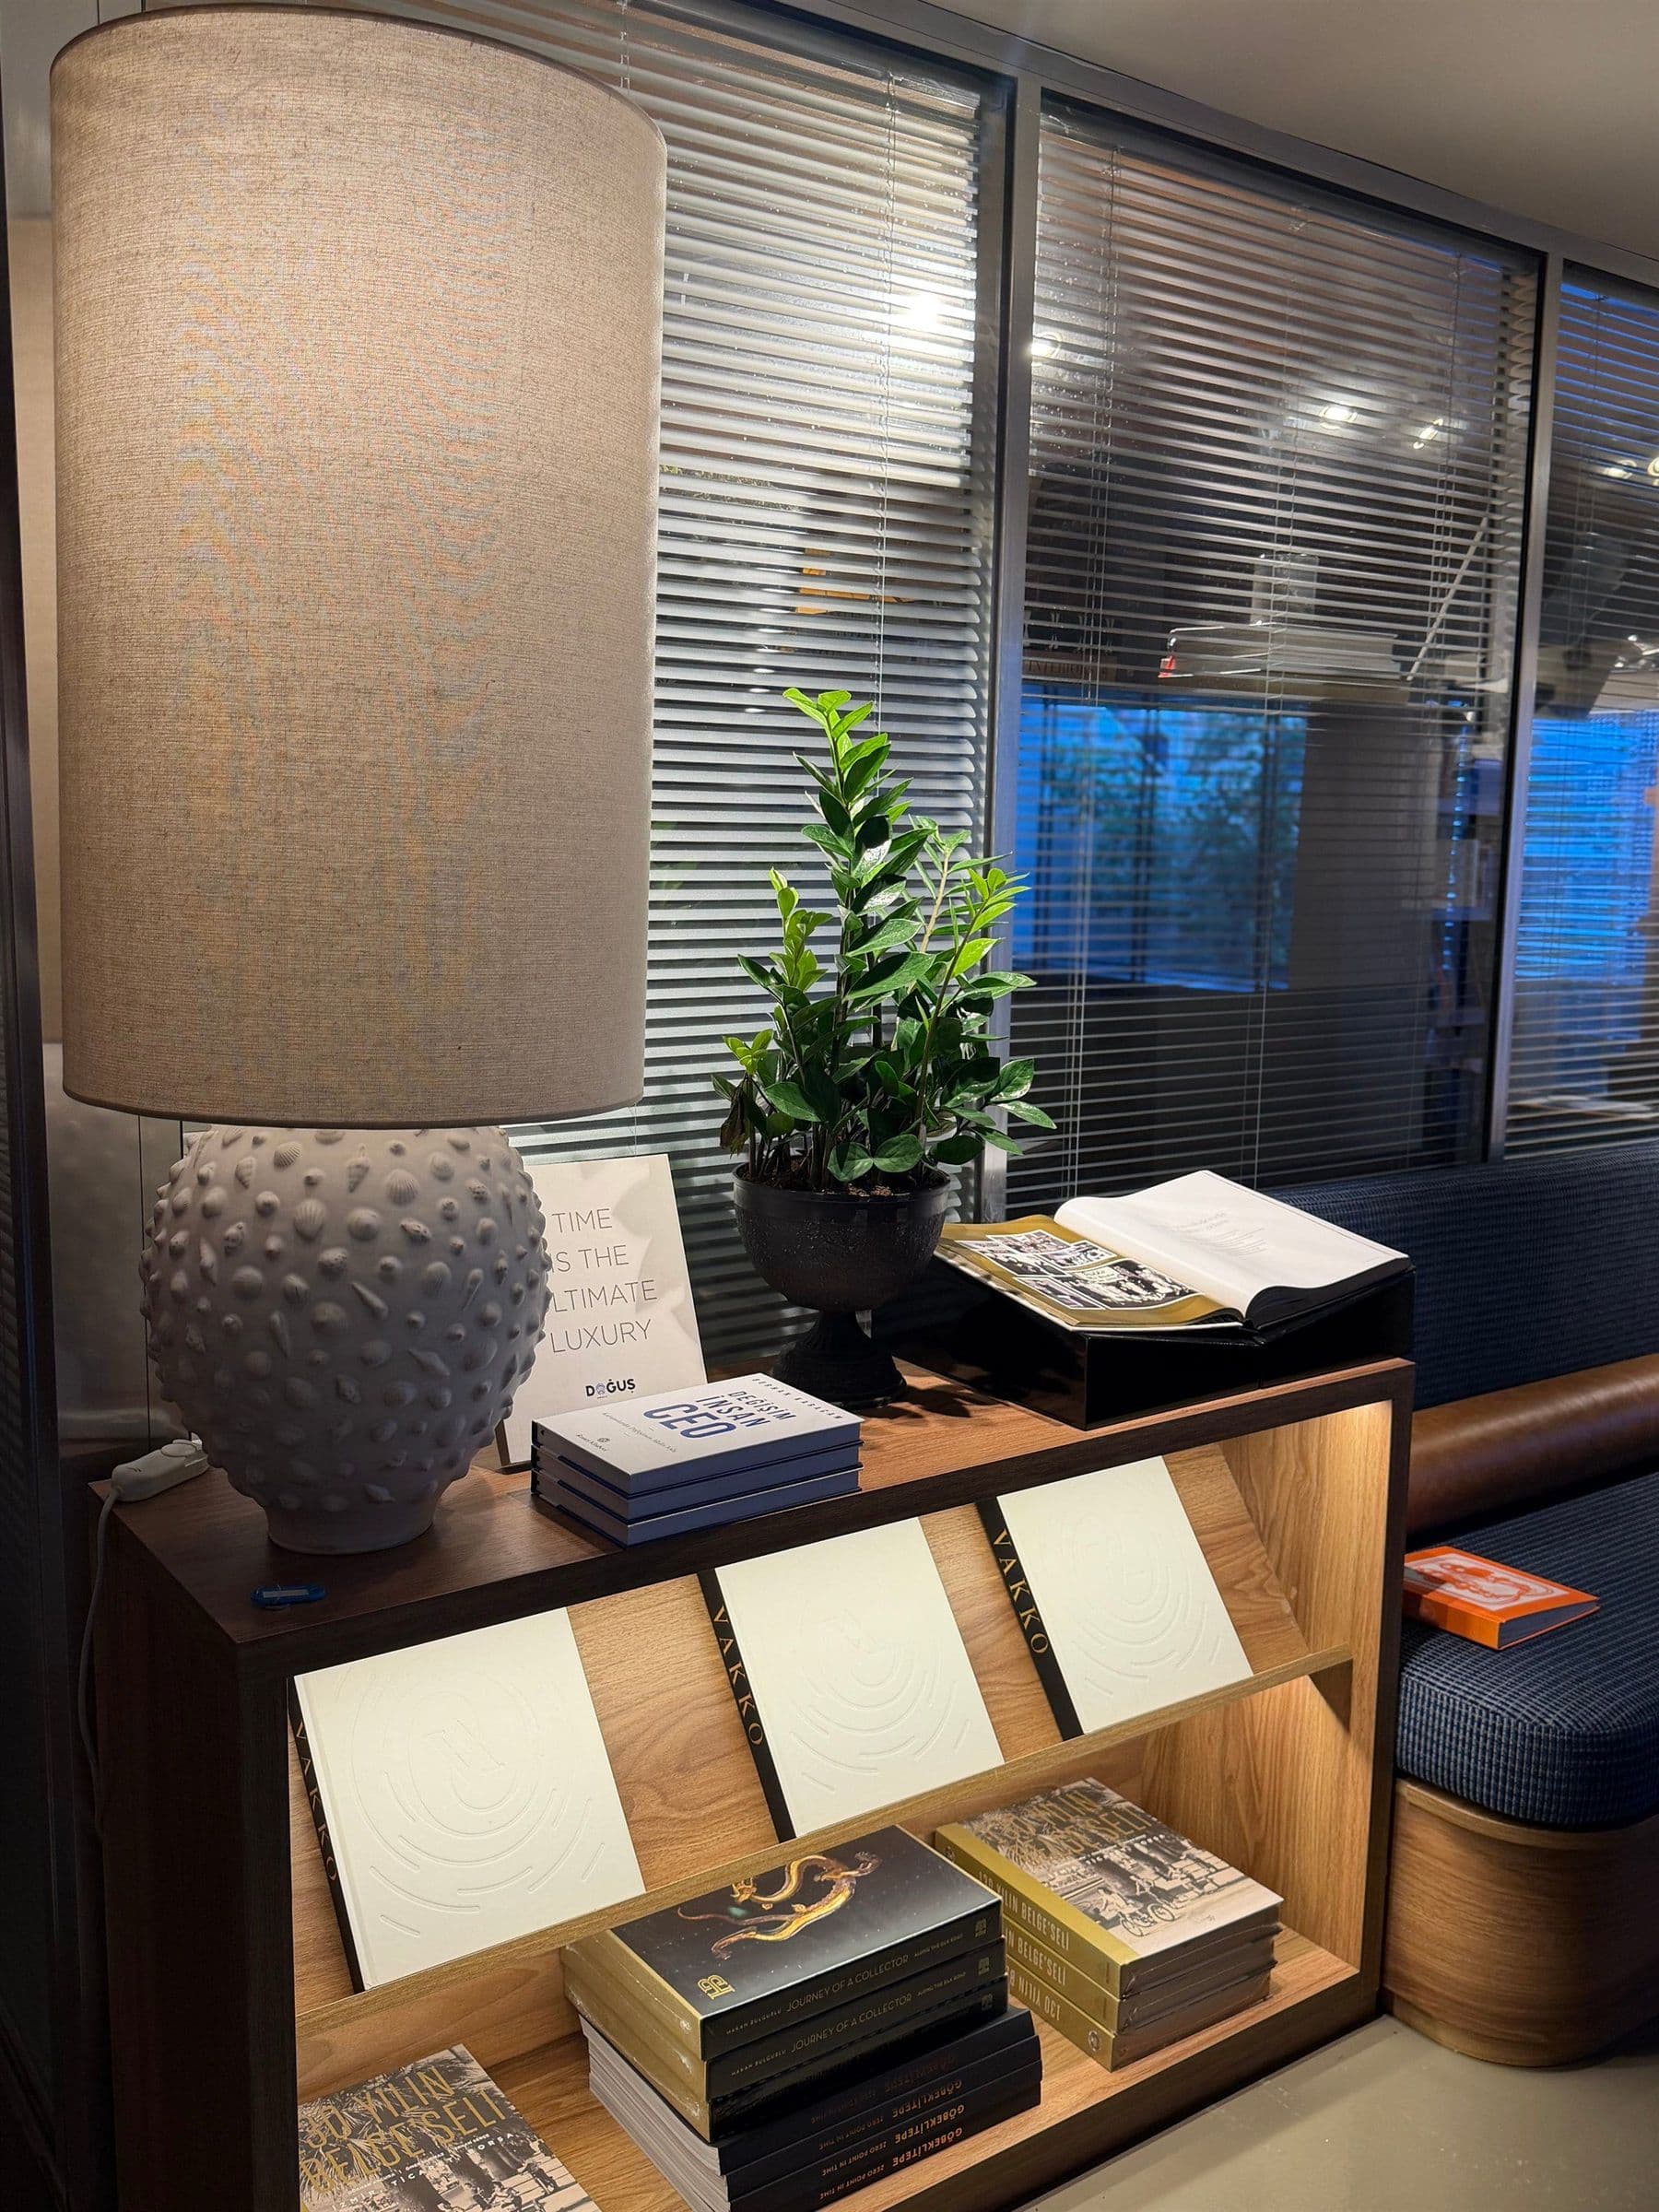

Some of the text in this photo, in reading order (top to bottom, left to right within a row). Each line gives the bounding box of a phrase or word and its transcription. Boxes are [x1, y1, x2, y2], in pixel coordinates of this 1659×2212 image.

[552, 1208, 612, 1233] TIME
[578, 1244, 629, 1269] THE
[553, 1279, 657, 1312] LTIMATE
[550, 1319, 651, 1353] LUXURY
[643, 1404, 737, 1439] CEO
[696, 1394, 771, 1427] İNSAN
[728, 1390, 797, 1421] DEĞİŞİM
[994, 1528, 1049, 1654] VAKKO
[713, 1606, 763, 1746] VAKKO
[296, 1721, 337, 1881] VAKKO
[1021, 1902, 1069, 1951] BELGE'SELİ
[1018, 1941, 1066, 1987] BELGE'SELİ
[786, 1986, 831, 2013] JOURNEY
[831, 1980, 846, 1994] OF
[847, 1977, 854, 1987] A
[855, 1954, 909, 1983] COLLECTOR
[1018, 1975, 1041, 2006] YILIN
[791, 2028, 834, 2053] JOURNEY
[836, 2019, 849, 2033] OF
[851, 2018, 858, 2026] A
[859, 1994, 912, 2023] COLLECTOR
[1043, 1994, 1061, 2021] 130
[352, 2065, 455, 2124] YILIN
[892, 2079, 962, 2118] GÖBEKLİTEPE
[821, 2104, 965, 2176] GÖBEKLİTEPE ZERO POINT IN TIME
[892, 2127, 962, 2167] GÖBEKLİTEPE
[846, 2174, 866, 2188] POINT
[867, 2164, 885, 2177] ZERO
[819, 2189, 835, 2200] TIME
